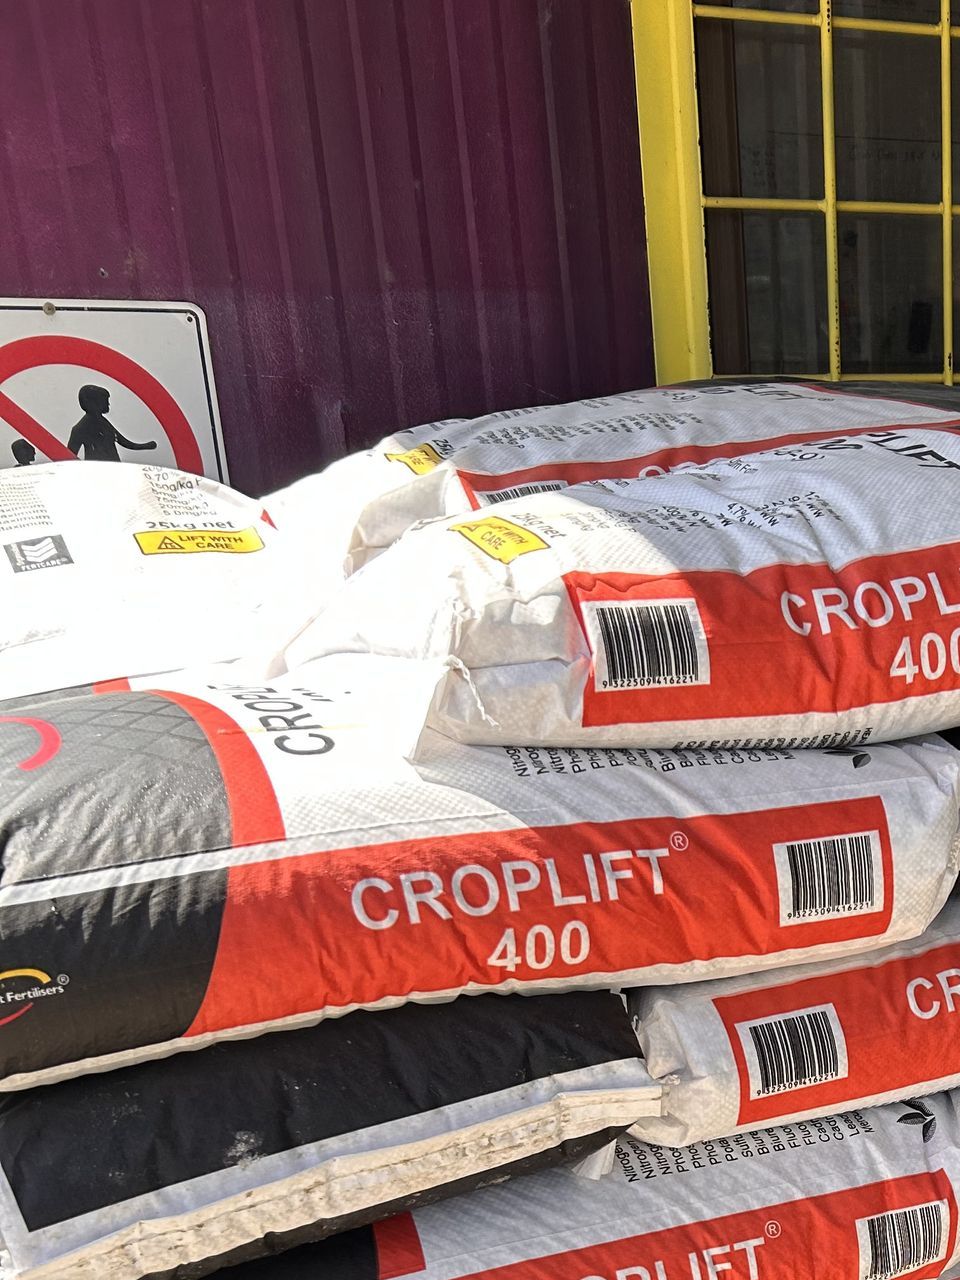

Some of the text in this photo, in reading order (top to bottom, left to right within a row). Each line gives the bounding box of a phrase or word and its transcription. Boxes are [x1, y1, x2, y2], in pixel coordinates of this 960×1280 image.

[146, 520, 236, 530] 25kg net
[209, 535, 243, 544] WITH
[196, 542, 234, 550] CARE
[612, 677, 652, 689] 322509
[656, 675, 694, 685] 416221
[796, 907, 831, 919] 322509
[835, 901, 869, 913] 416221
[487, 919, 590, 972] 400
